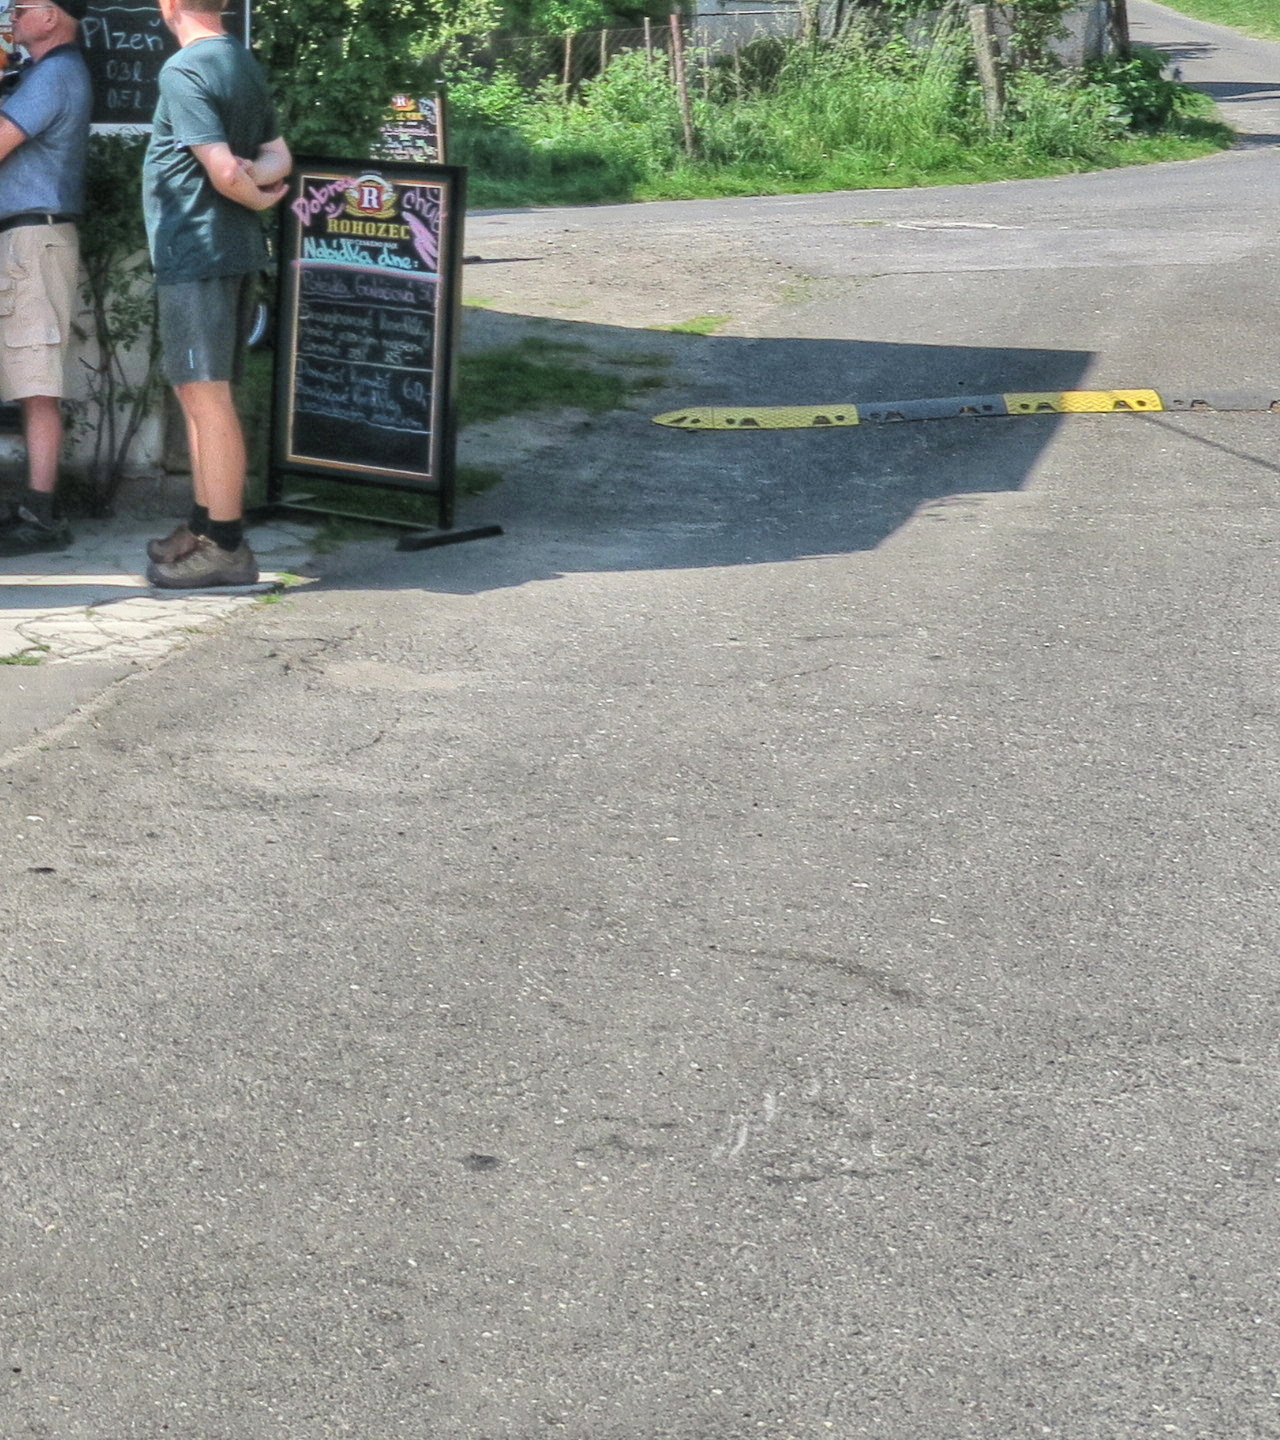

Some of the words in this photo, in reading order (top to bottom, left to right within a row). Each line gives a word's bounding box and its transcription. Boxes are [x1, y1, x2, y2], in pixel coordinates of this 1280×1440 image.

[81, 16, 164, 51] Plzeň
[360, 186, 380, 209] R
[327, 218, 412, 239] ROHOZEC
[303, 236, 373, 265] Nabídka
